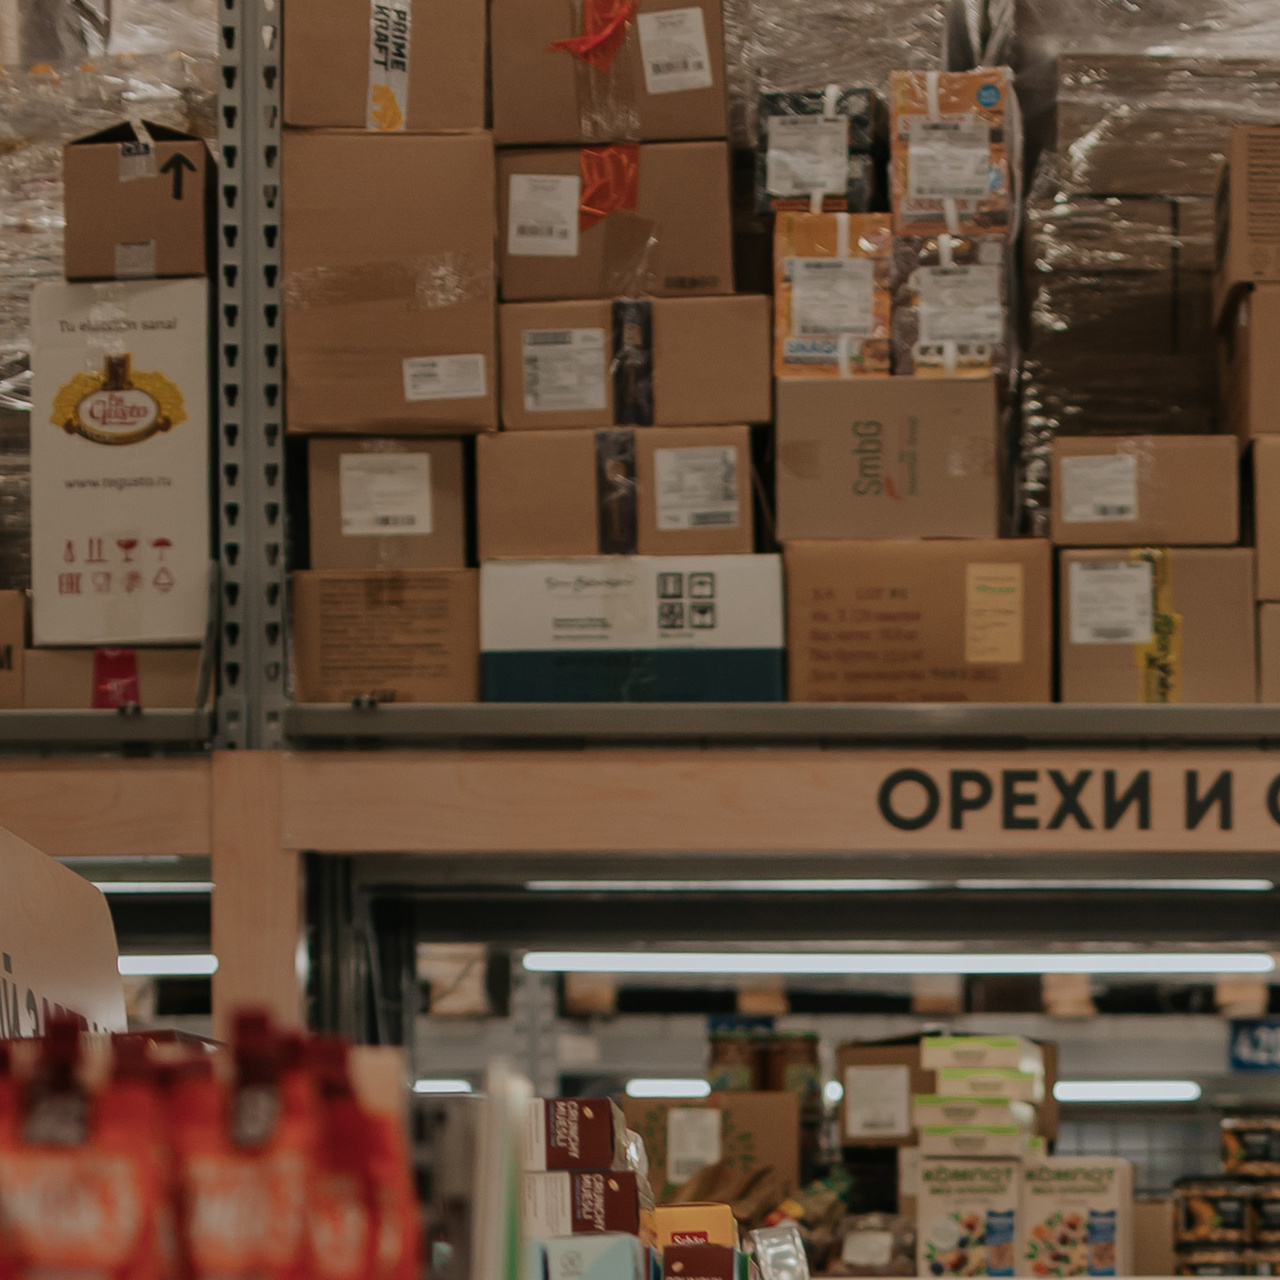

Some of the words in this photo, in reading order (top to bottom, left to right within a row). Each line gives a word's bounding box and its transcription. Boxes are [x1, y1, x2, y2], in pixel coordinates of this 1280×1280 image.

[373, 5, 389, 71] KRAFT
[391, 9, 407, 72] PRIME
[852, 420, 883, 496] SmbG
[876, 767, 1151, 832] ОРЕХИ
[1184, 769, 1232, 831] И
[555, 1101, 567, 1147] MUESLI
[566, 1101, 580, 1159] CRUNCHY
[581, 1174, 593, 1219] MUESLI
[592, 1173, 606, 1231] CRUNCHY
